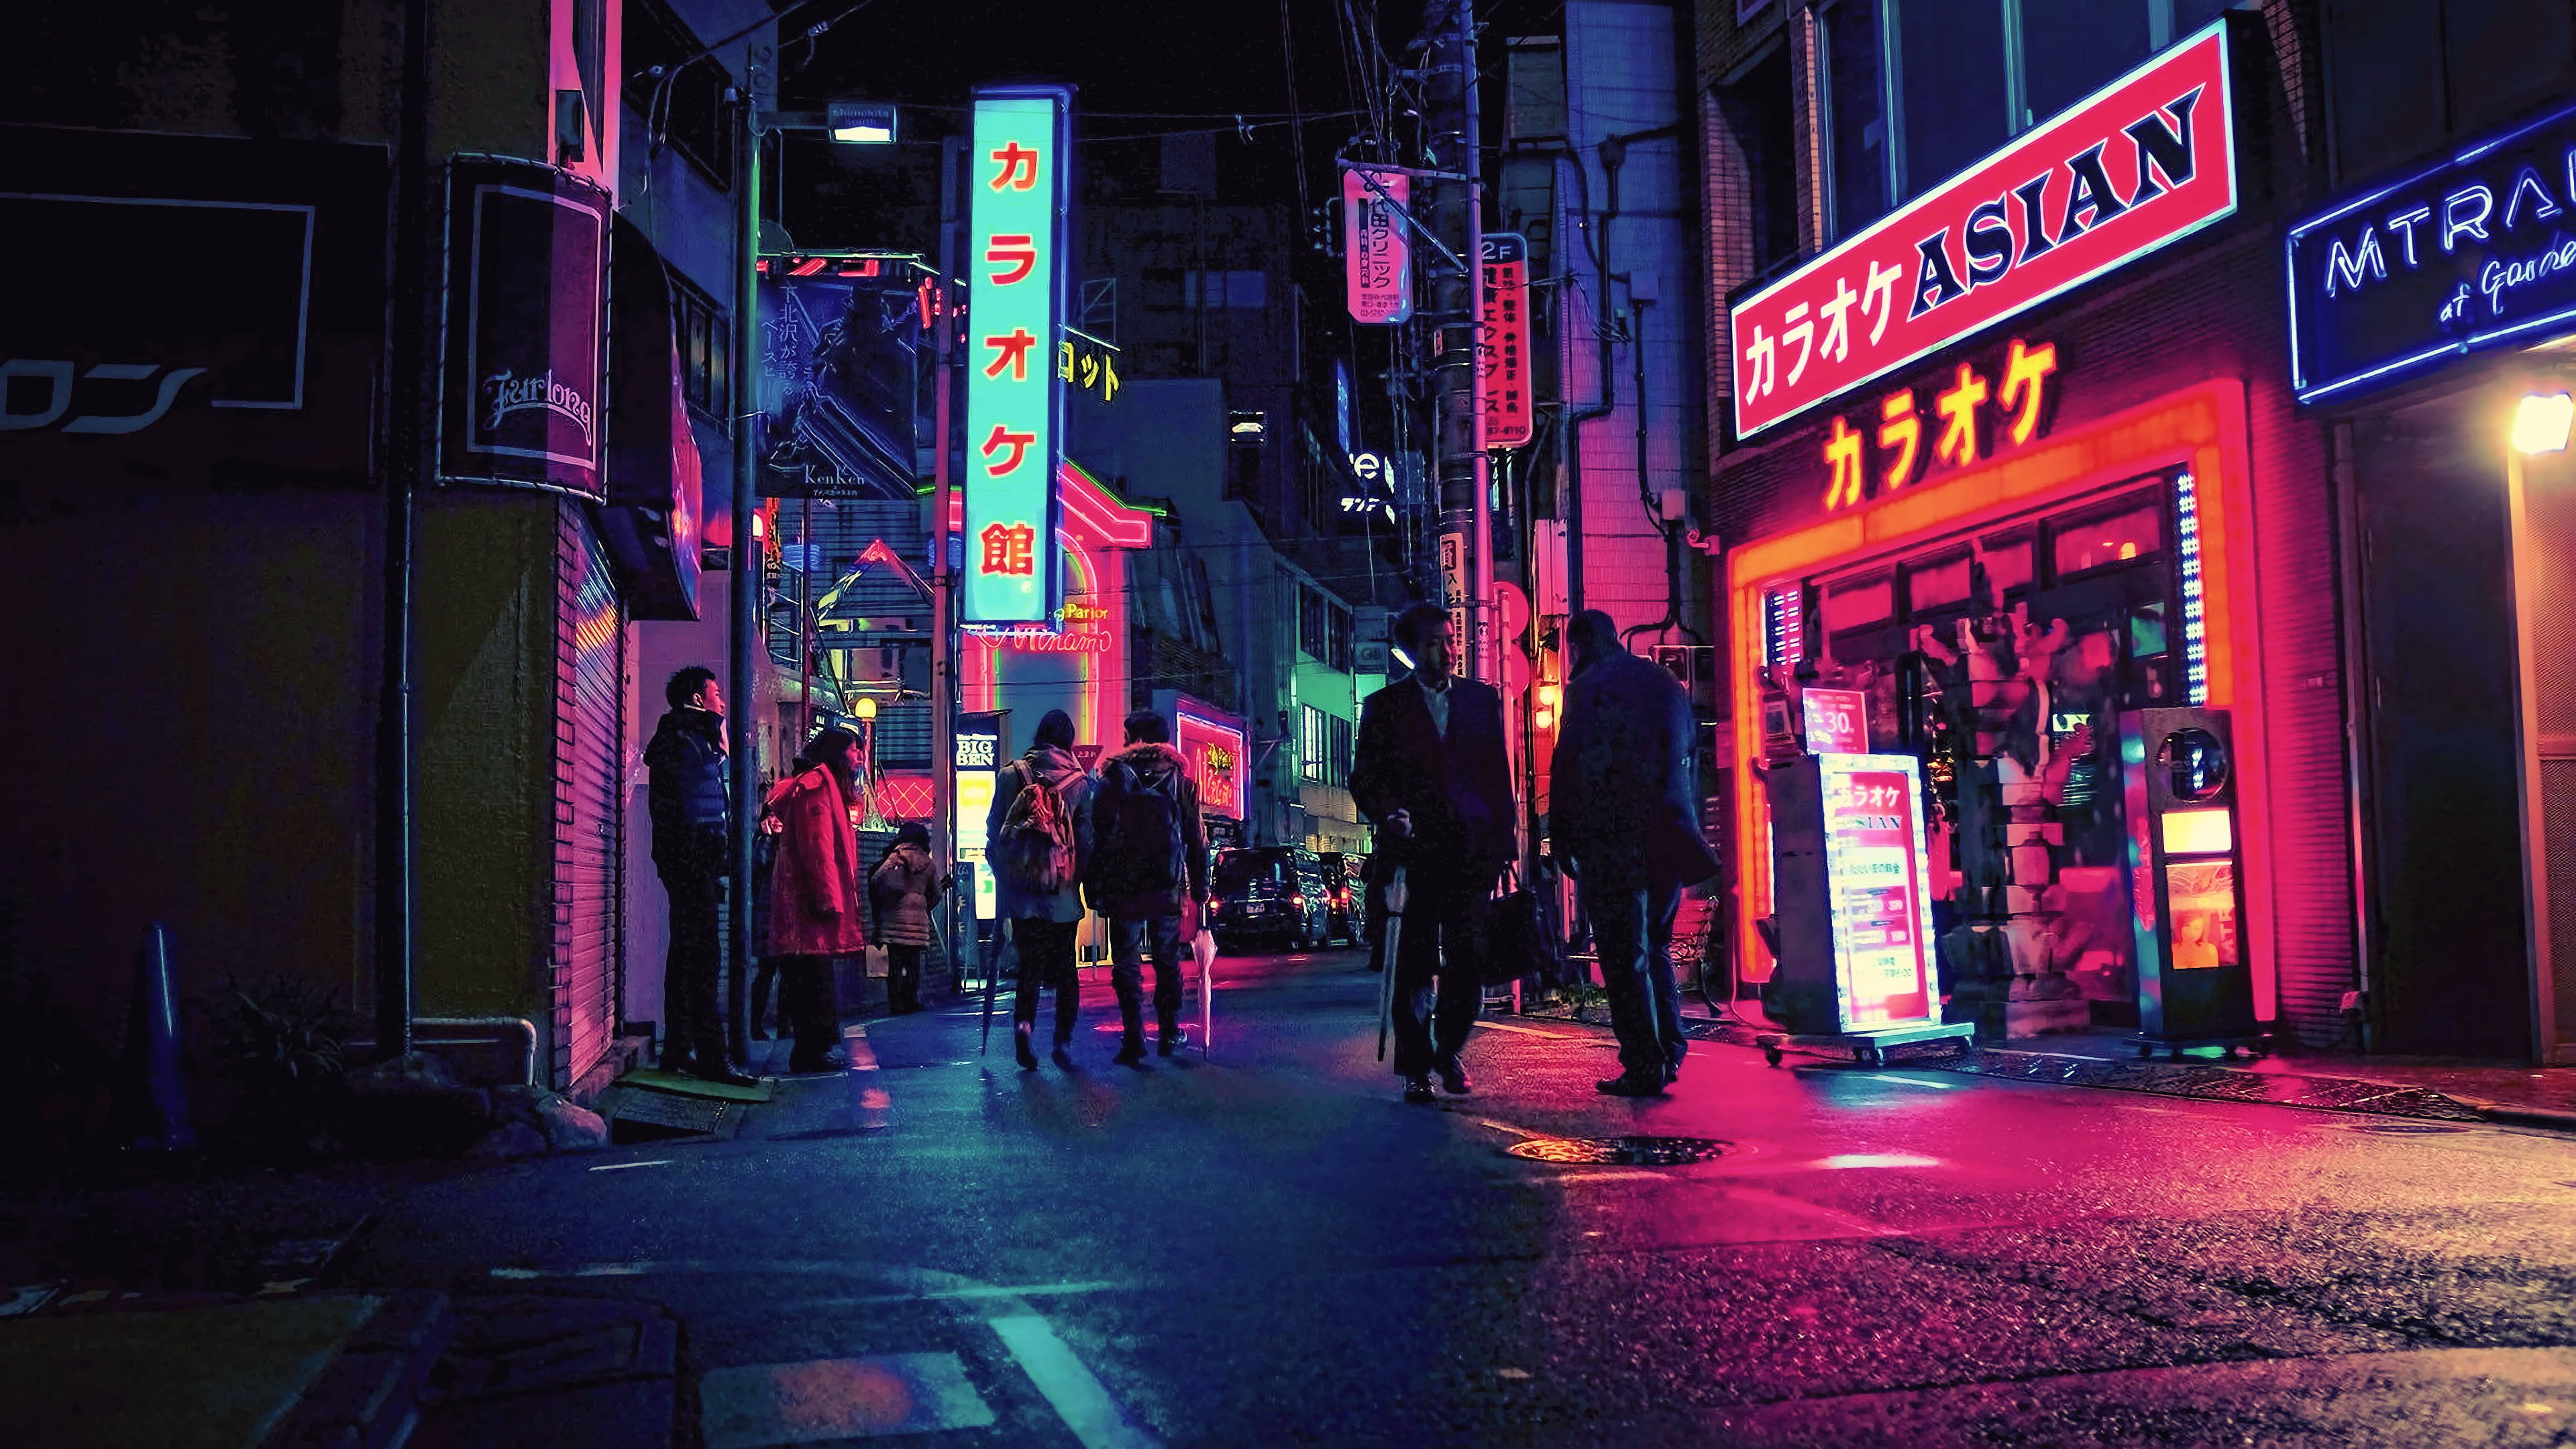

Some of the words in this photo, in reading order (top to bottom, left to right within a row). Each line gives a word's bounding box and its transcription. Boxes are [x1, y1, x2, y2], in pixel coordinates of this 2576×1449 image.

[1746, 260, 1902, 406] カラオケ
[1906, 83, 2207, 323] ASIAN
[2326, 148, 2576, 298] MTRA
[981, 140, 1038, 577] カラオケ館
[1824, 339, 2056, 511] カラオケ
[956, 752, 995, 767] BEN
[957, 741, 993, 754] BIG
[1836, 816, 1902, 829] SIAN
